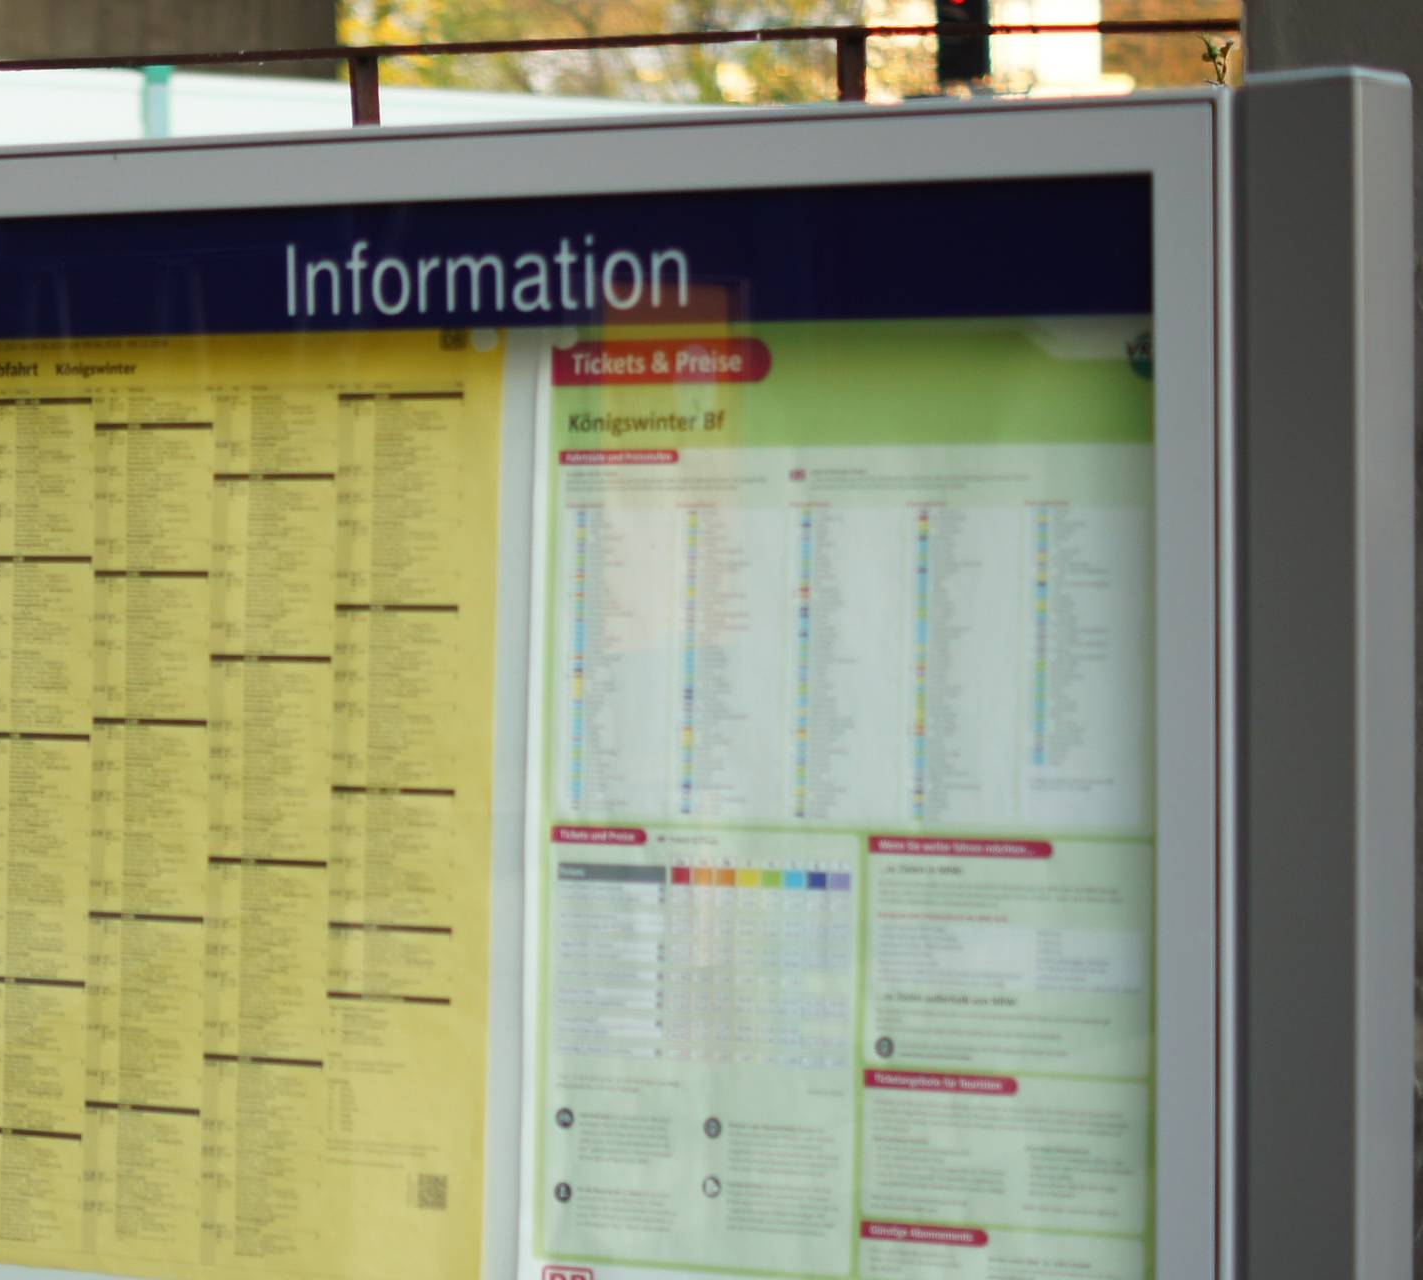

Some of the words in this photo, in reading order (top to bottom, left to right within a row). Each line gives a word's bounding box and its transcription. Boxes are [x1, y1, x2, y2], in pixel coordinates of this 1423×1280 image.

[286, 234, 688, 317] Information
[55, 361, 137, 378] Königswinter
[571, 351, 645, 375] Tickets
[651, 351, 670, 374] &
[676, 349, 742, 373] Preise
[568, 412, 696, 437] Königswinter
[703, 409, 726, 431] Bf
